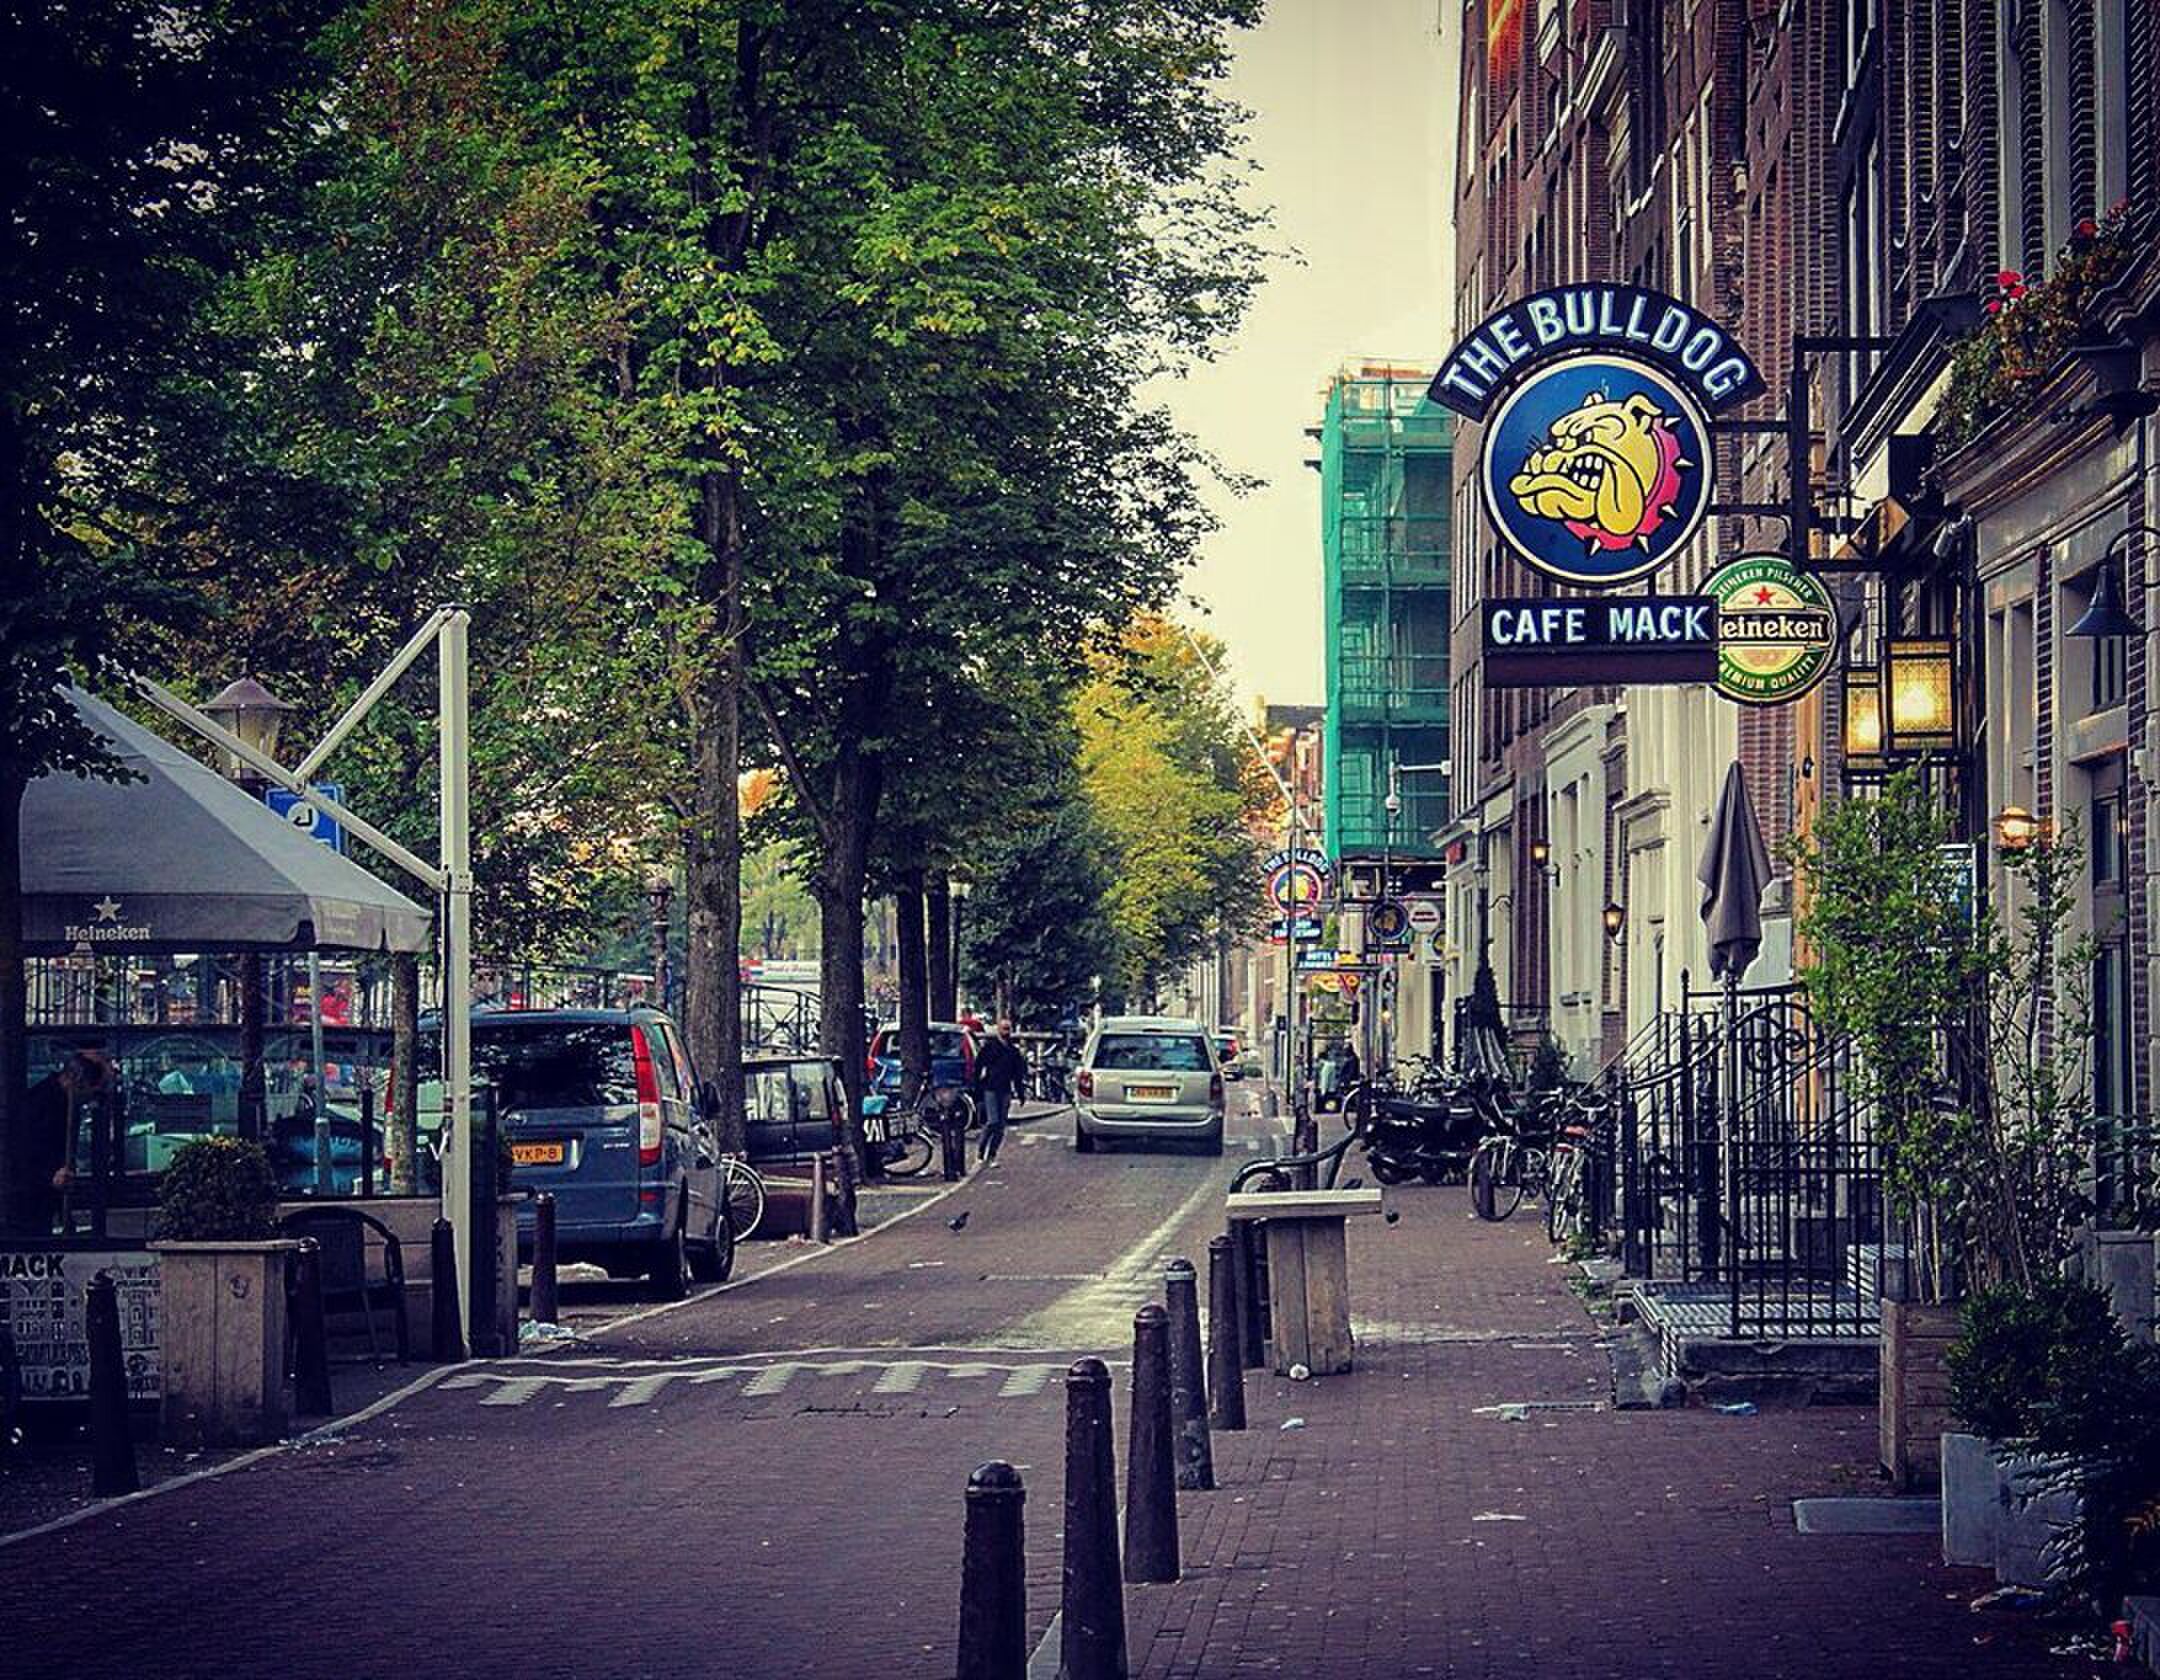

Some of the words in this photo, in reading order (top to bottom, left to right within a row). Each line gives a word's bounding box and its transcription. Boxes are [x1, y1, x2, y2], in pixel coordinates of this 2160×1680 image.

[1440, 316, 1532, 400] THE
[1527, 291, 1749, 401] BULLDOG
[1719, 568, 1762, 594] EINEKEN
[1491, 607, 1586, 643] CAFE
[1609, 605, 1709, 642] MACK
[1282, 850, 1329, 873] BLLDOG
[65, 925, 149, 941] Heineken
